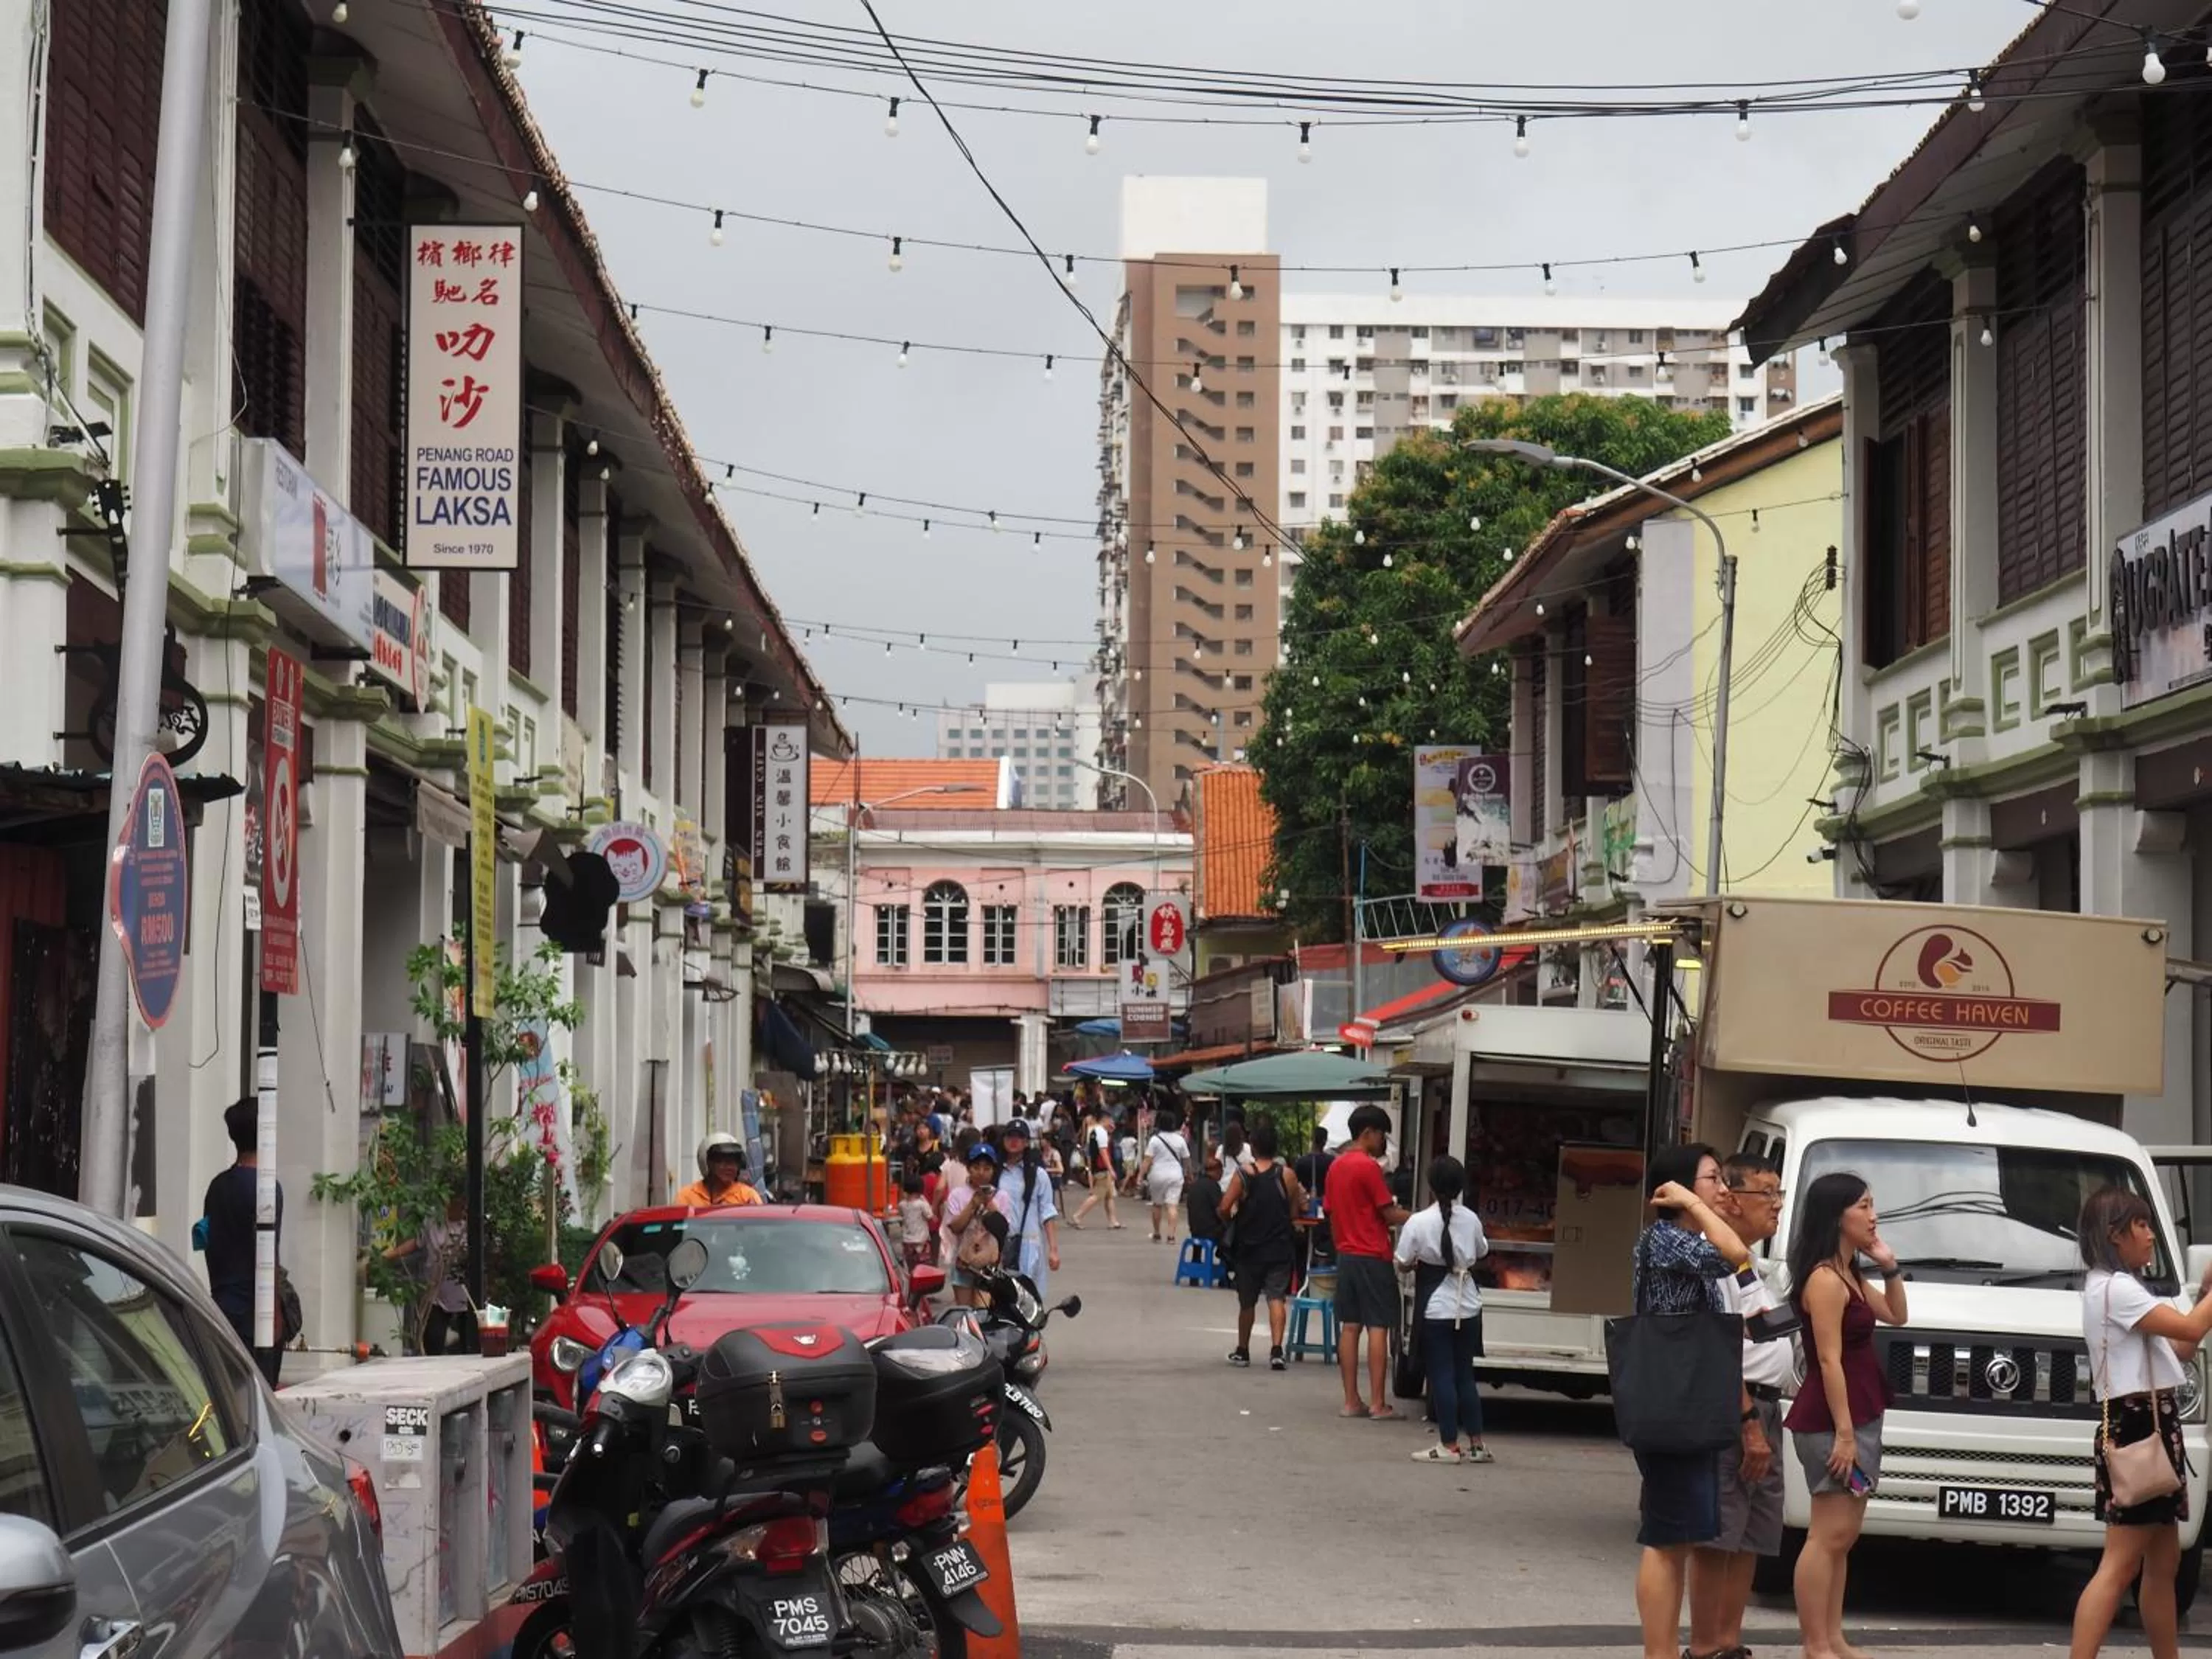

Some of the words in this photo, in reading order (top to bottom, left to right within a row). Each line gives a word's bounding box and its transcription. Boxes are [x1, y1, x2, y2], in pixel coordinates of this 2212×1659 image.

[432, 277, 500, 306] 馳名
[417, 447, 473, 462] PENANG
[476, 447, 514, 463] ROAD
[416, 466, 512, 492] FAMOUS
[416, 495, 512, 526] LAKSA
[433, 543, 465, 554] Since
[468, 543, 494, 554] 1970
[1859, 998, 1944, 1021] COFFEE
[1955, 1002, 2029, 1026] HAVEN
[386, 1407, 428, 1427] SECK
[1944, 1490, 1987, 1514] PMB
[1999, 1493, 2049, 1517] 1392
[944, 1559, 977, 1586] 4146
[773, 1596, 819, 1618] PMS
[773, 1615, 830, 1636] 7045
